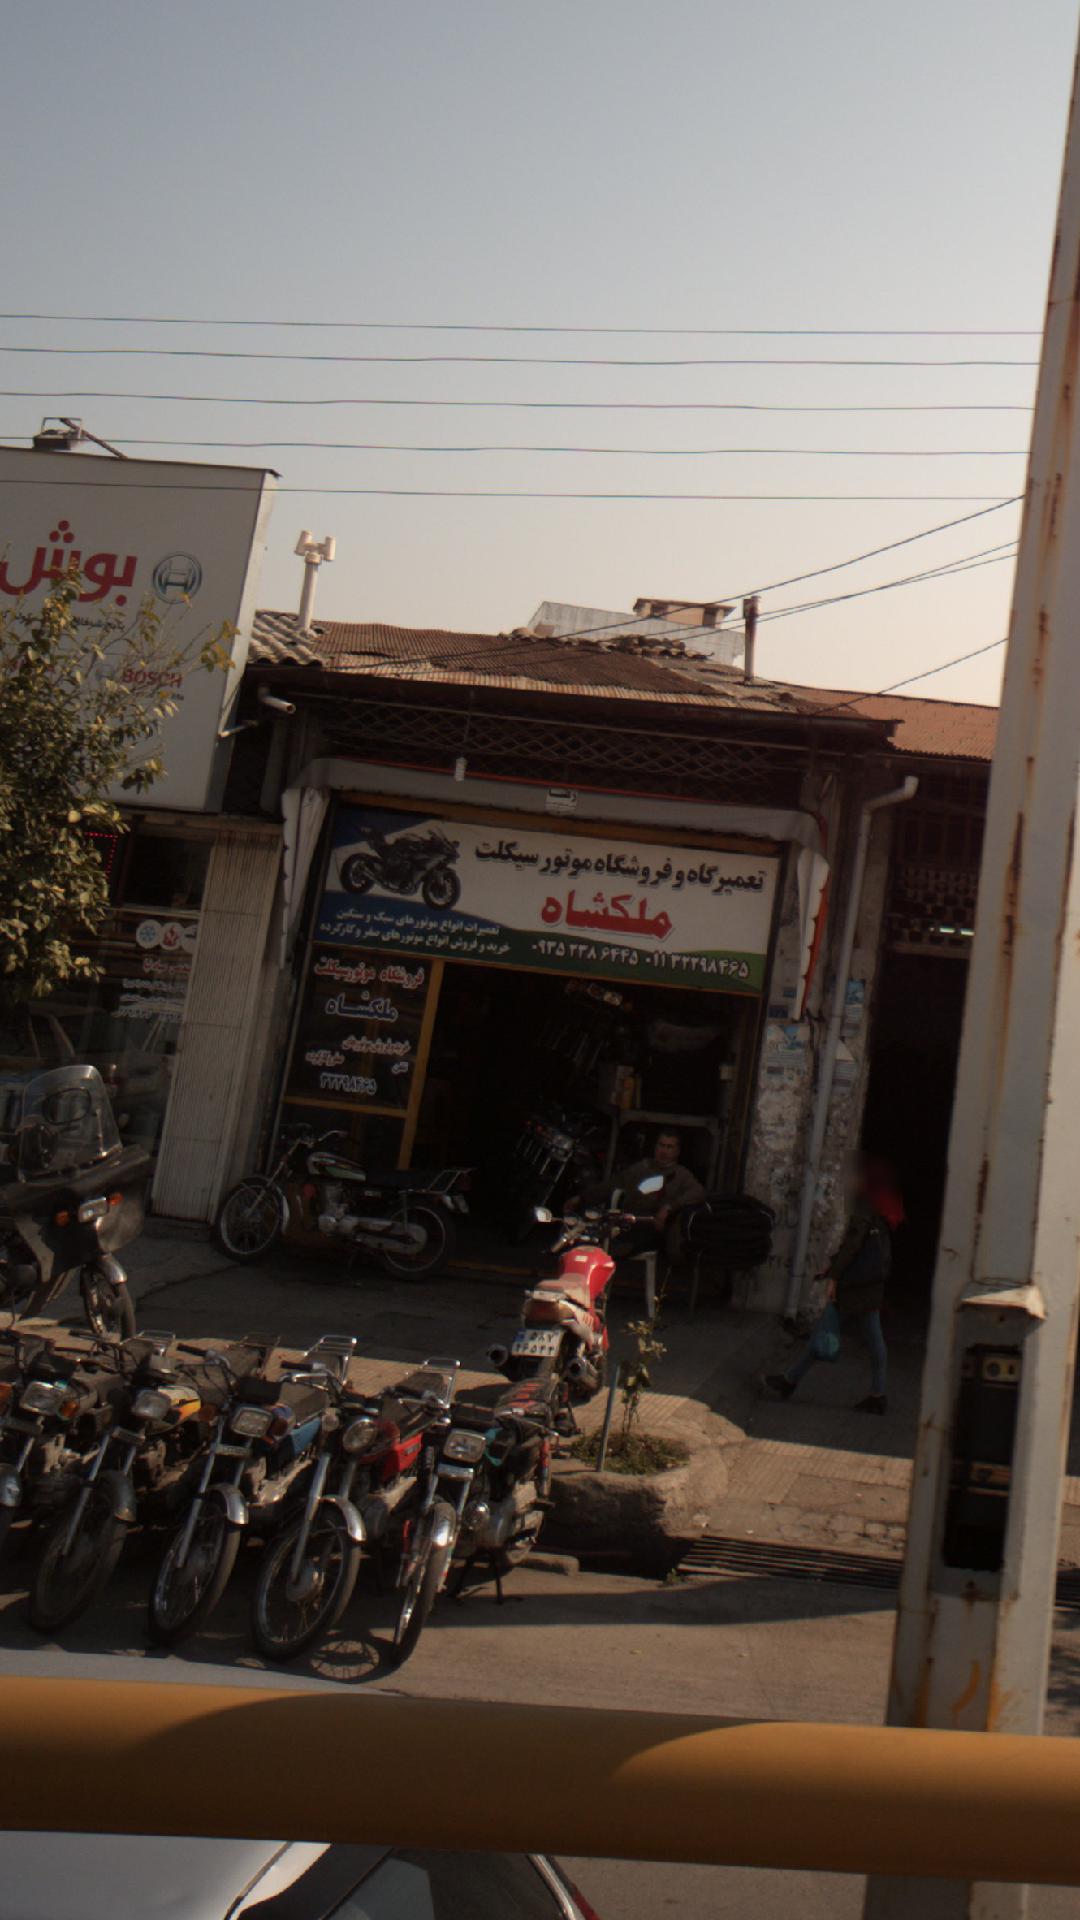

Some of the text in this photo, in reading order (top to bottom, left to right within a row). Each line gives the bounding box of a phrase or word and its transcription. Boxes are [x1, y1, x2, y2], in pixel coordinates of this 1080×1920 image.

[0, 520, 137, 606] بوش
[121, 669, 183, 688] BOSCH
[594, 853, 672, 885] فروشگاه
[672, 871, 684, 891] و
[373, 911, 394, 923] سبک
[541, 889, 674, 940] ملکشاه
[439, 916, 464, 934] انواع
[464, 921, 500, 936] تعمیرات
[425, 934, 449, 948] انواع
[450, 936, 477, 951] فروش
[486, 941, 511, 956] خرید
[380, 965, 425, 989] فروشگاه
[325, 990, 399, 1023] ملکشاه
